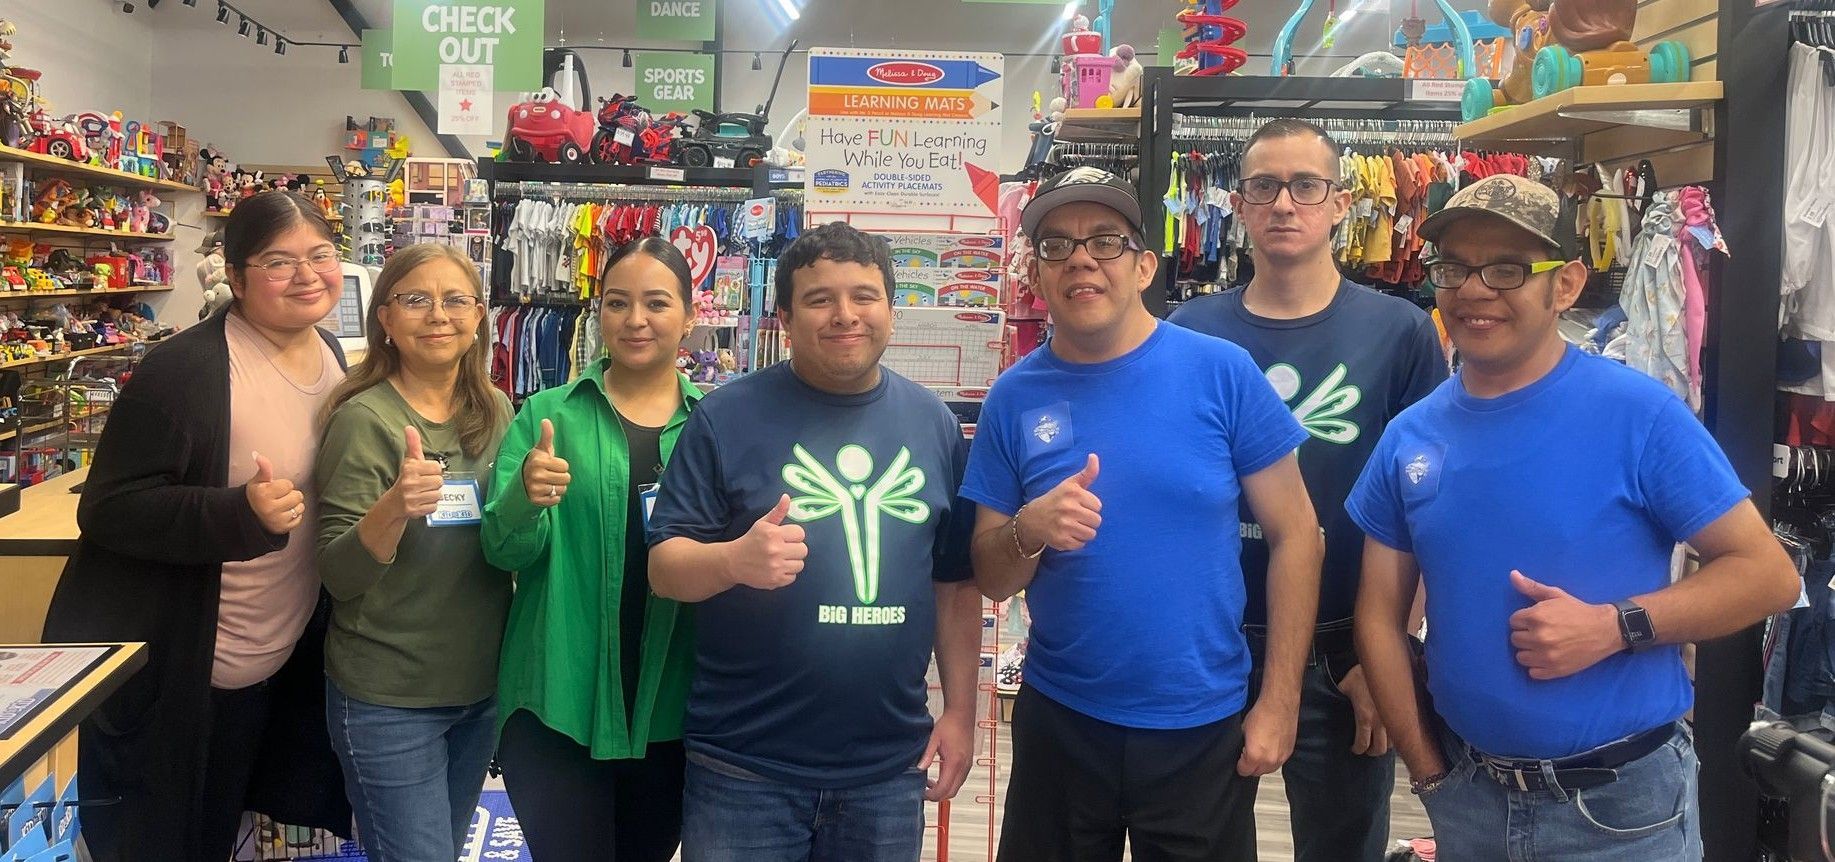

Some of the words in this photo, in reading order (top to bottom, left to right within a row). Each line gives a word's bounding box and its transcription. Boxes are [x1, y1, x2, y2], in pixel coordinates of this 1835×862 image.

[651, 2, 700, 17] DANCE
[422, 5, 516, 34] CHECK
[438, 36, 499, 64] OUT
[644, 68, 705, 84] SPORTS
[875, 67, 908, 78] Melissa
[917, 69, 936, 80] Doug
[653, 85, 694, 100] GEAR
[844, 94, 919, 109] LEARNING
[925, 97, 965, 111] MATS
[820, 128, 862, 146] Have
[868, 129, 908, 147] FUN
[914, 131, 987, 156] Learning
[844, 149, 893, 168] While
[898, 151, 924, 169] You
[929, 151, 962, 171] Eat!
[874, 173, 931, 181] DOUBLE-SIDED
[900, 183, 943, 191] PLACEMATS
[894, 234, 931, 245] Vehicles
[851, 606, 906, 625] HEROES
